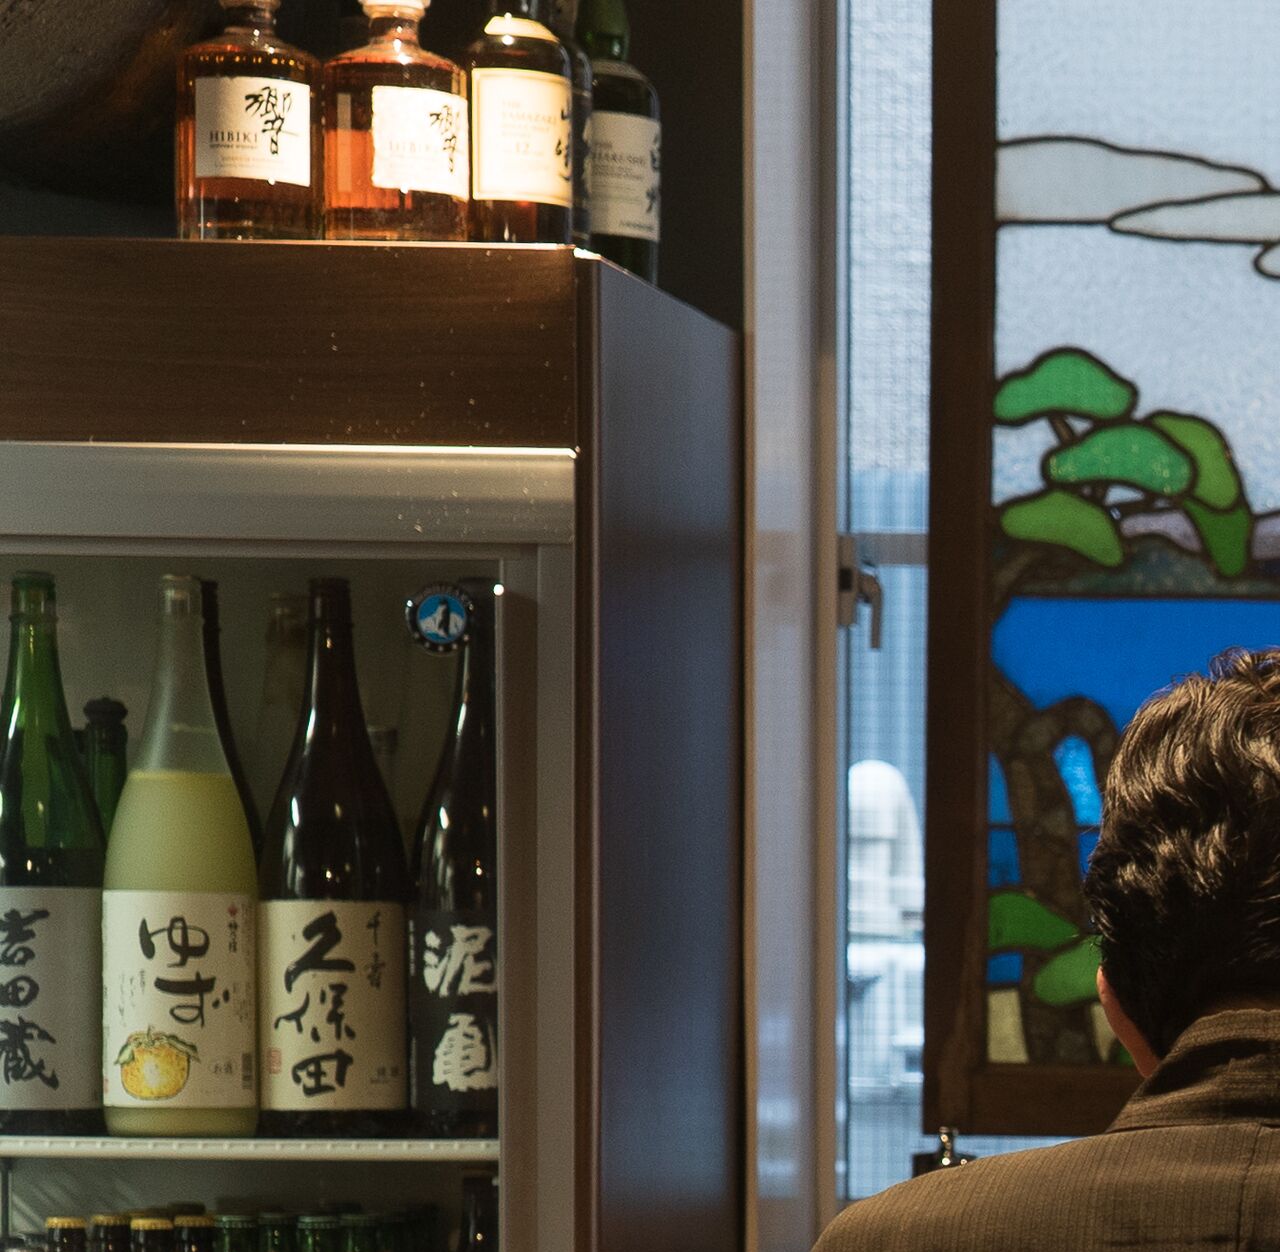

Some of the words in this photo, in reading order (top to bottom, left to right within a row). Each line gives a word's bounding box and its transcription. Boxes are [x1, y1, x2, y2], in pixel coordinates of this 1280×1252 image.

[210, 131, 258, 143] HIBIKI
[139, 917, 230, 1028] ゆず
[274, 910, 356, 1096] 久保田
